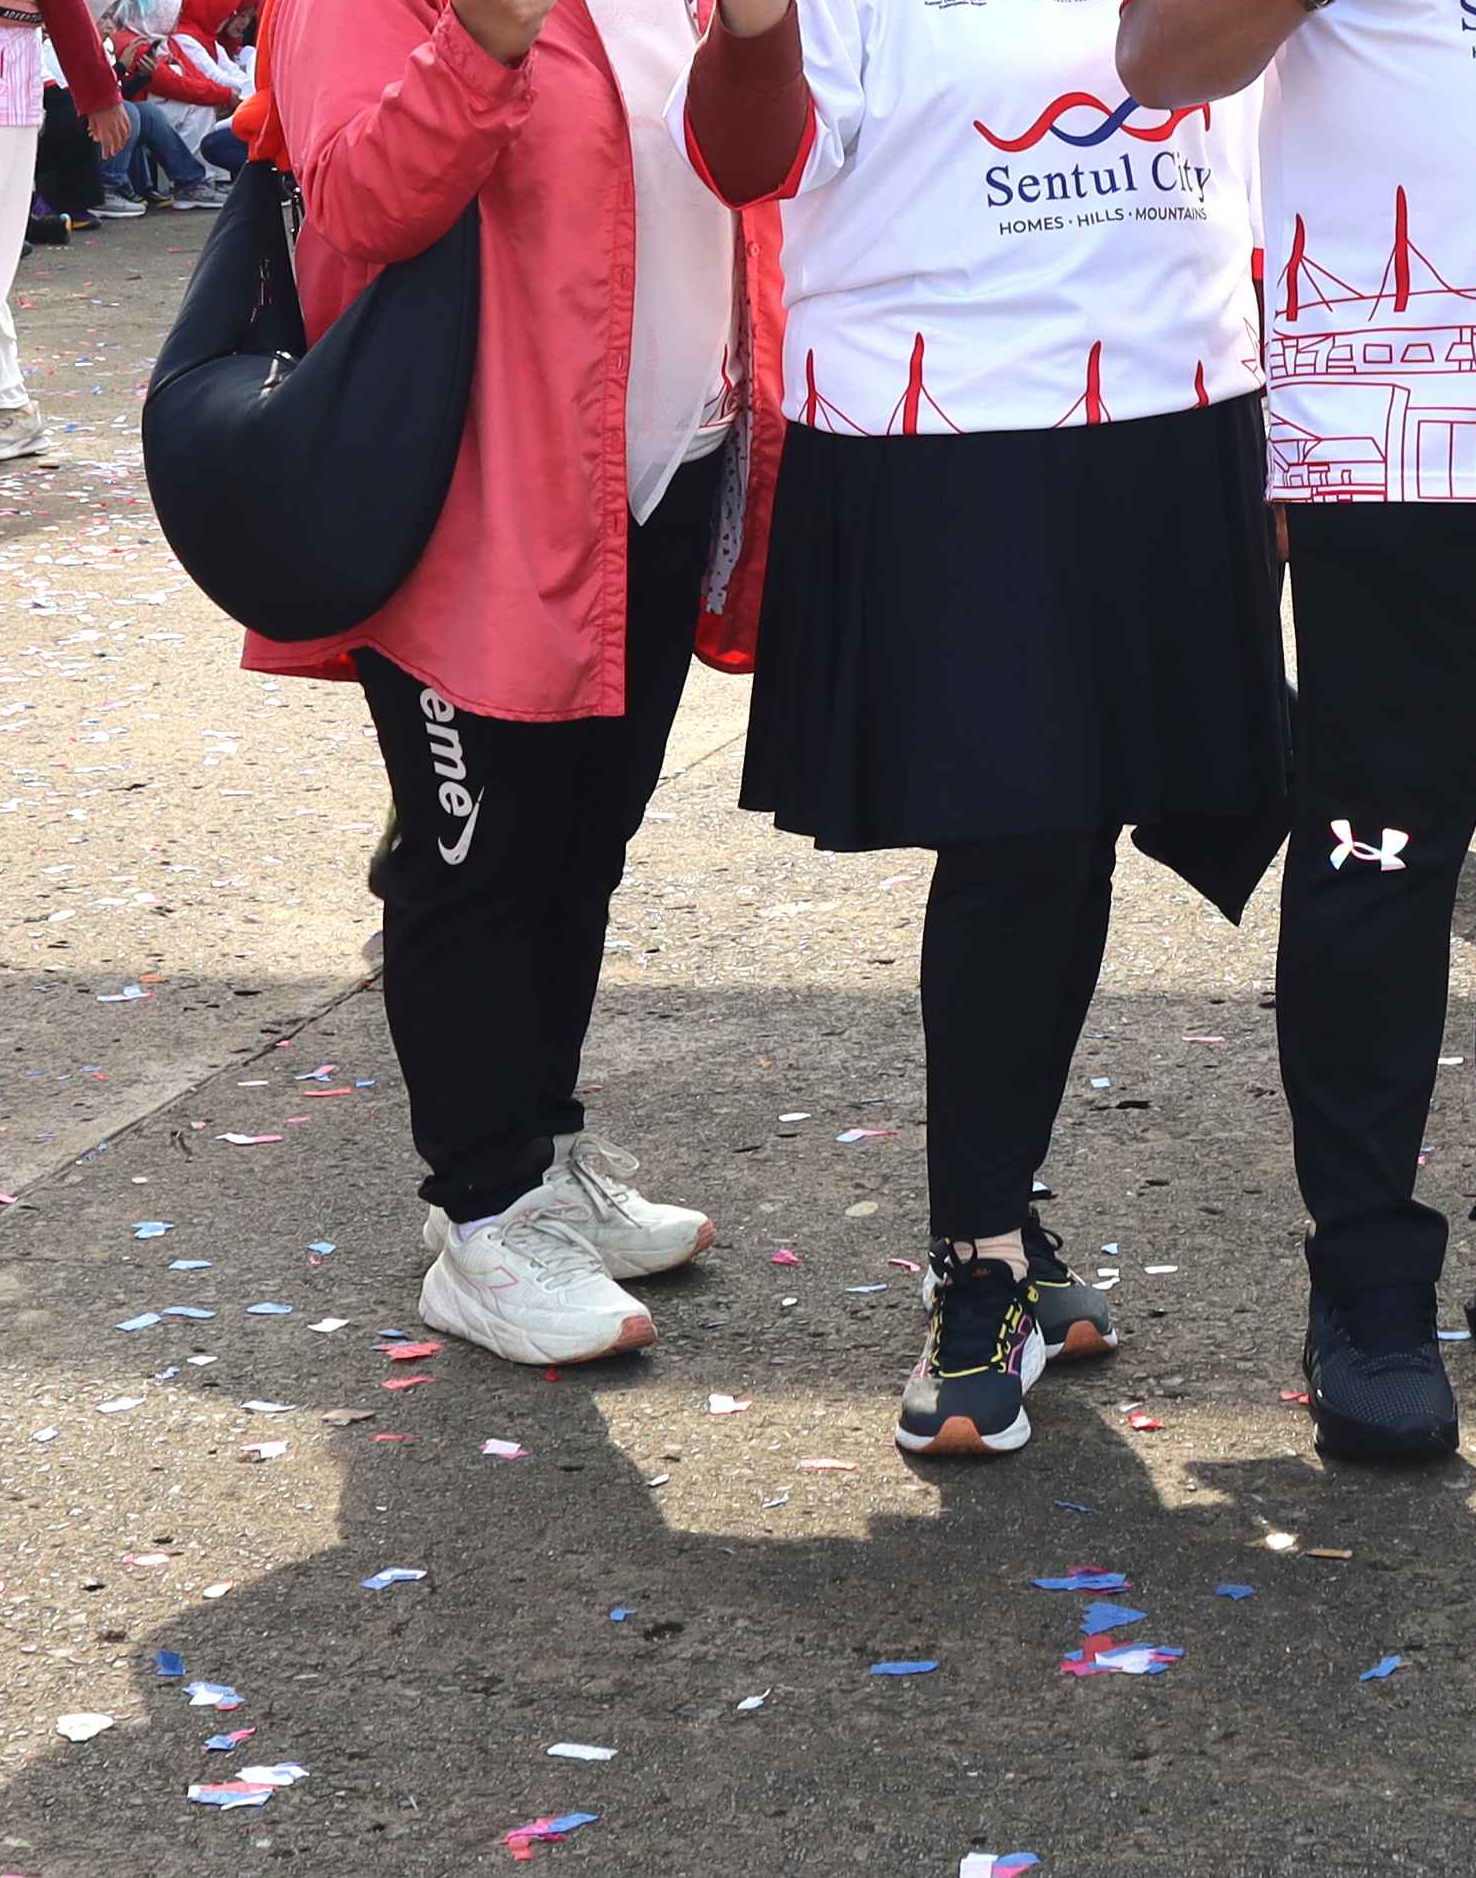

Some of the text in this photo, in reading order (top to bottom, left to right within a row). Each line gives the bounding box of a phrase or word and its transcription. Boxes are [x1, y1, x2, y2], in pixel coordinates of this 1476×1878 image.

[985, 151, 1212, 208] Sentul City
[999, 206, 1208, 236] HOMES HILLS MOUNTAINS
